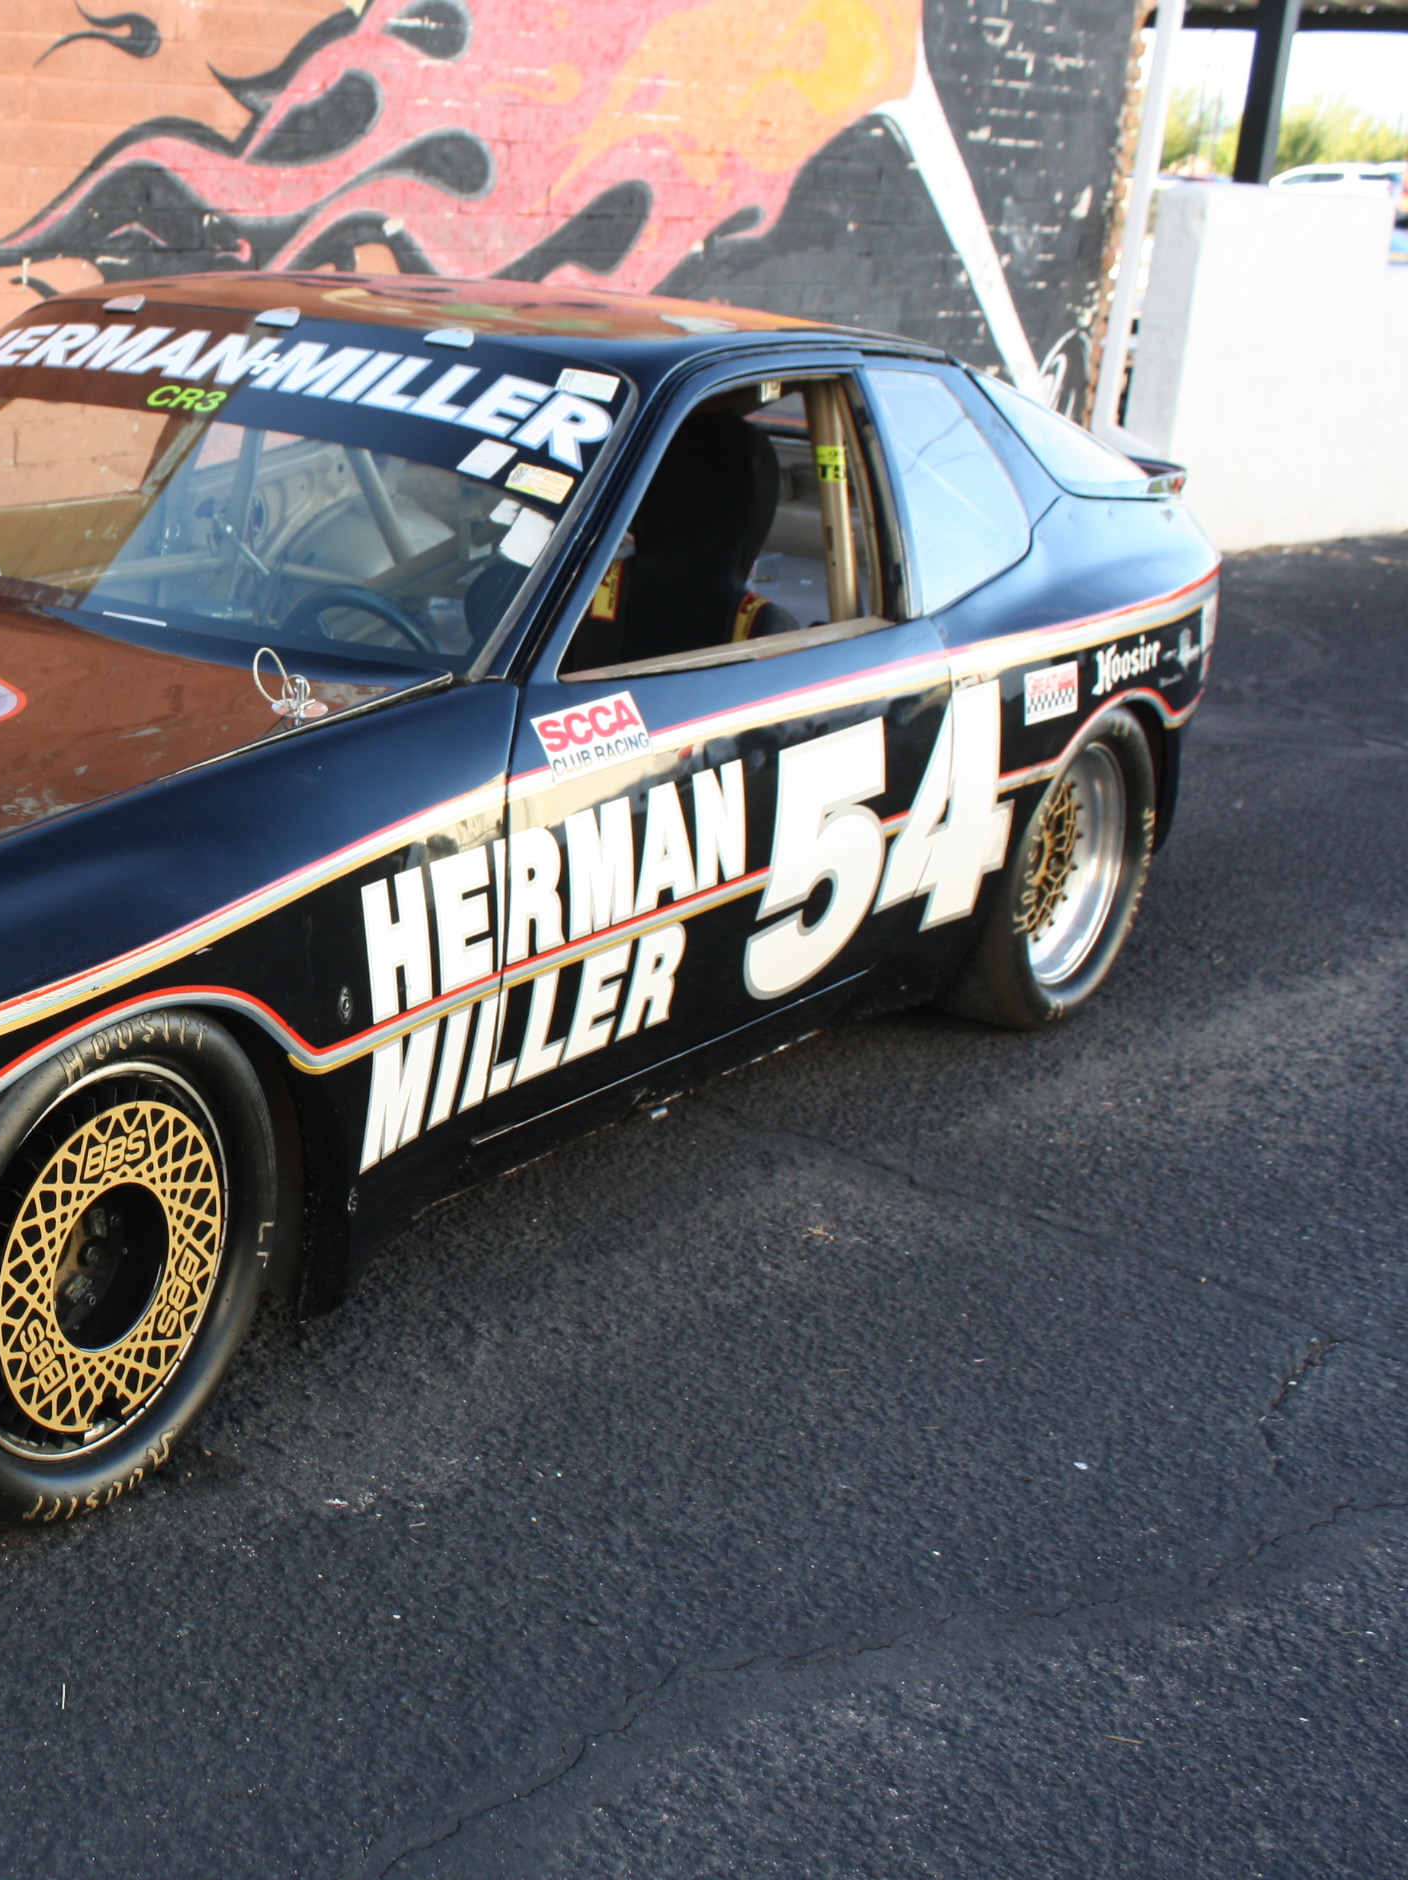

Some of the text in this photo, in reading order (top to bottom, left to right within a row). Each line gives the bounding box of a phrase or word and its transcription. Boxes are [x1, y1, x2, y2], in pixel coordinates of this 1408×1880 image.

[146, 385, 227, 412] CR3
[1091, 634, 1161, 696] Hoosier
[537, 698, 641, 753] SCCA
[552, 731, 650, 777] CLUB RACING
[742, 679, 1015, 1000] 54
[361, 759, 746, 1024] HERMAN
[358, 921, 687, 1175] MILLER
[83, 1129, 148, 1180] BBS
[157, 1248, 200, 1339] BBS
[19, 1317, 68, 1396] BBS
